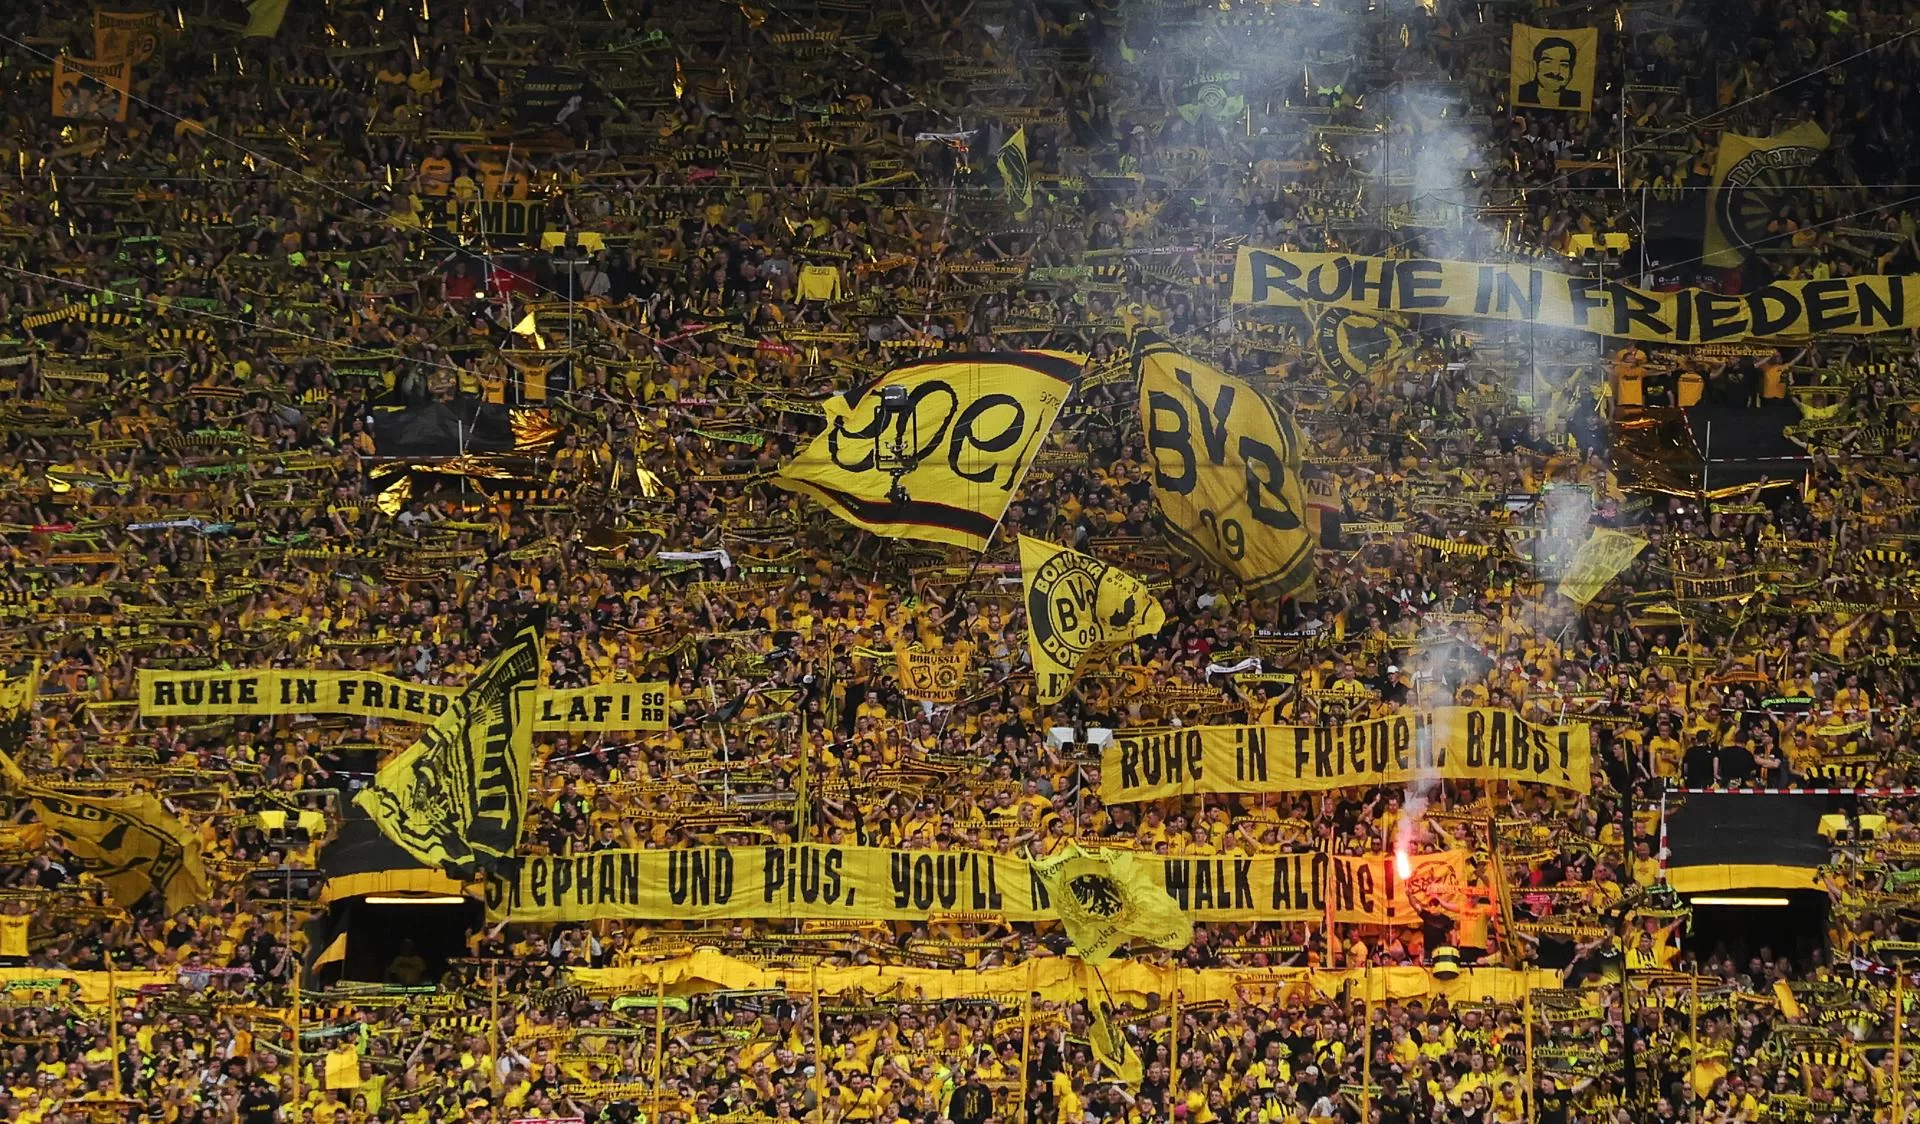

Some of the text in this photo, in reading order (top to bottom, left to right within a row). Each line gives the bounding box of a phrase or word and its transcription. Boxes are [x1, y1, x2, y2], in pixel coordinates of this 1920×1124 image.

[1249, 249, 1904, 343] RUHE IN FRIEDEN
[1147, 368, 1302, 530] BVB
[1035, 552, 1104, 594] BORUSSIA
[909, 653, 961, 665] BORUSSIA
[154, 679, 258, 706] RUHE
[280, 678, 318, 705] IN
[642, 692, 664, 707] SG
[642, 708, 664, 722] RB
[1467, 711, 1569, 782] BABS!
[668, 847, 734, 907] UND
[1165, 858, 1254, 911] WALK
